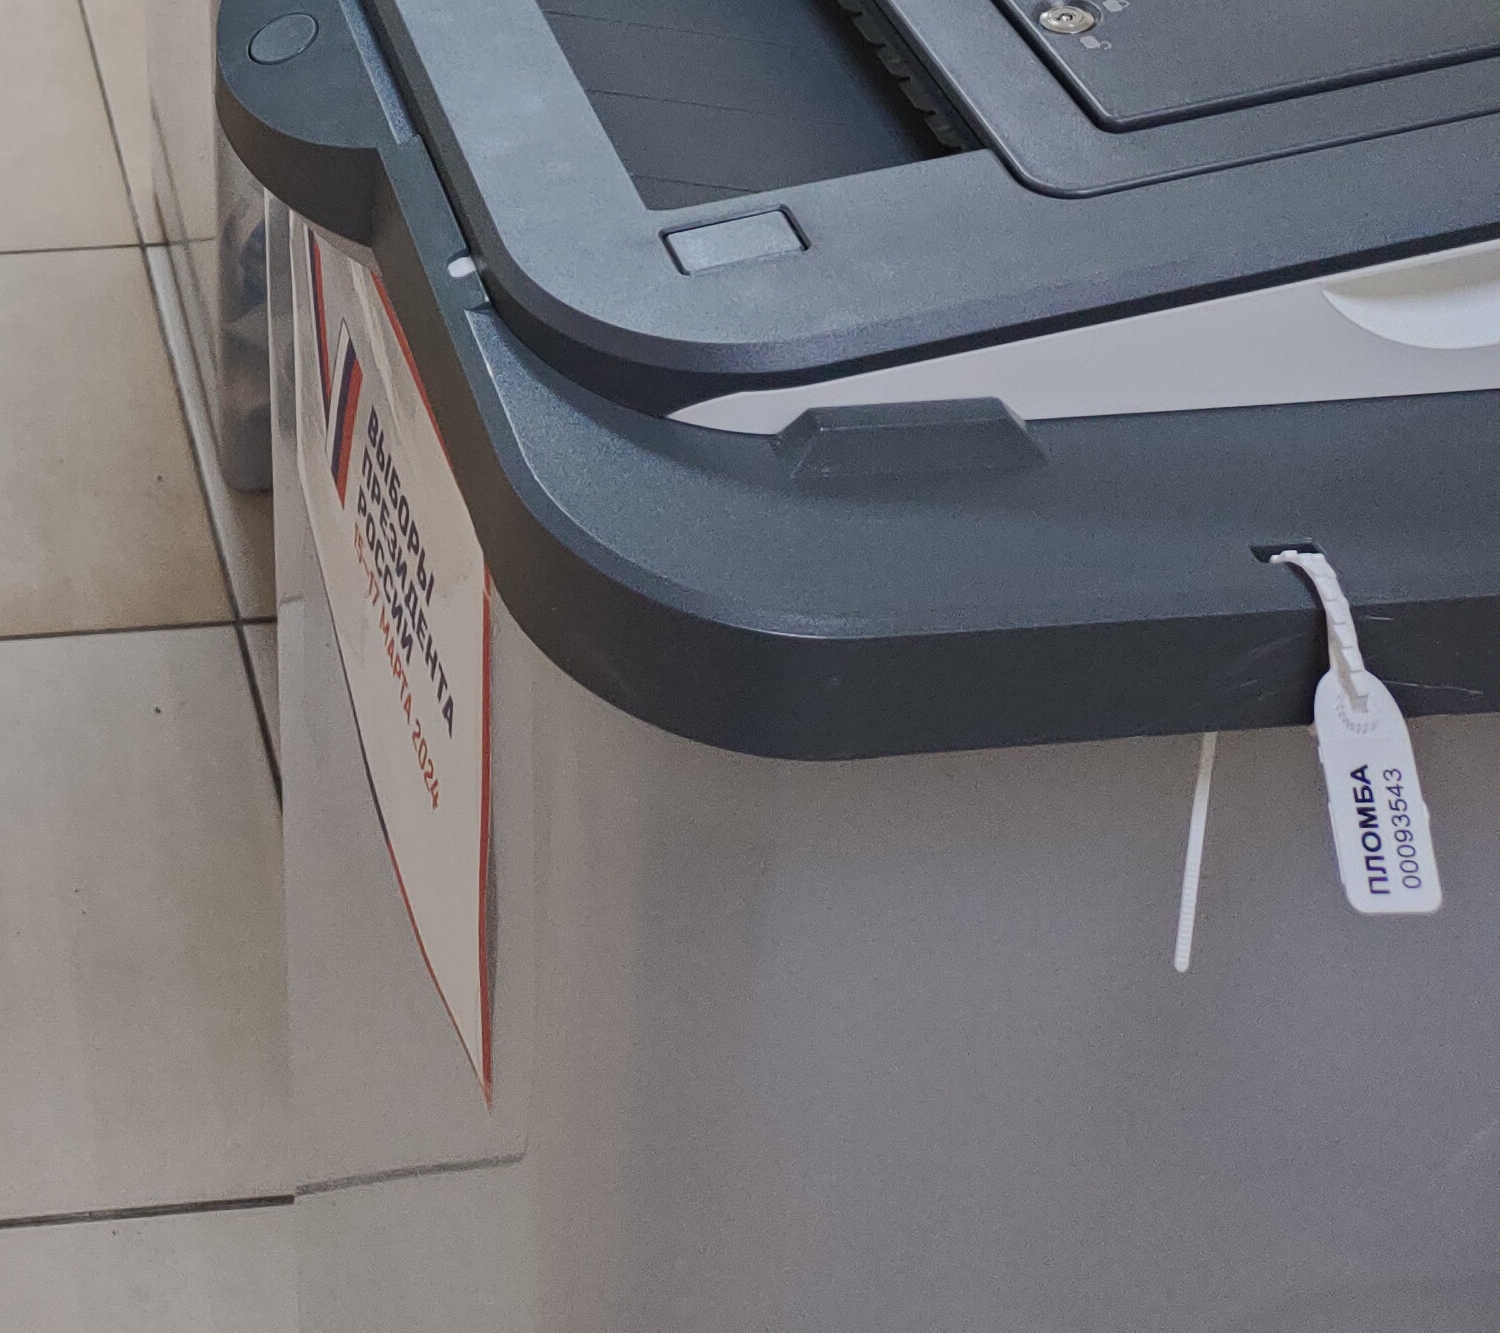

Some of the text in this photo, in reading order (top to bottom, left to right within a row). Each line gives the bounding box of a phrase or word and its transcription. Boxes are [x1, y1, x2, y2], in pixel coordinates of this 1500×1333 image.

[357, 485, 412, 665] РОССИИ
[361, 445, 454, 739] ПРЕЗИДЕНТА
[367, 404, 435, 607] ВЫБОРЫ
[379, 609, 412, 726] МАРТА
[411, 718, 440, 810] 2024
[1350, 764, 1391, 894] ПЛОМБА
[1383, 768, 1422, 889] 00093543
